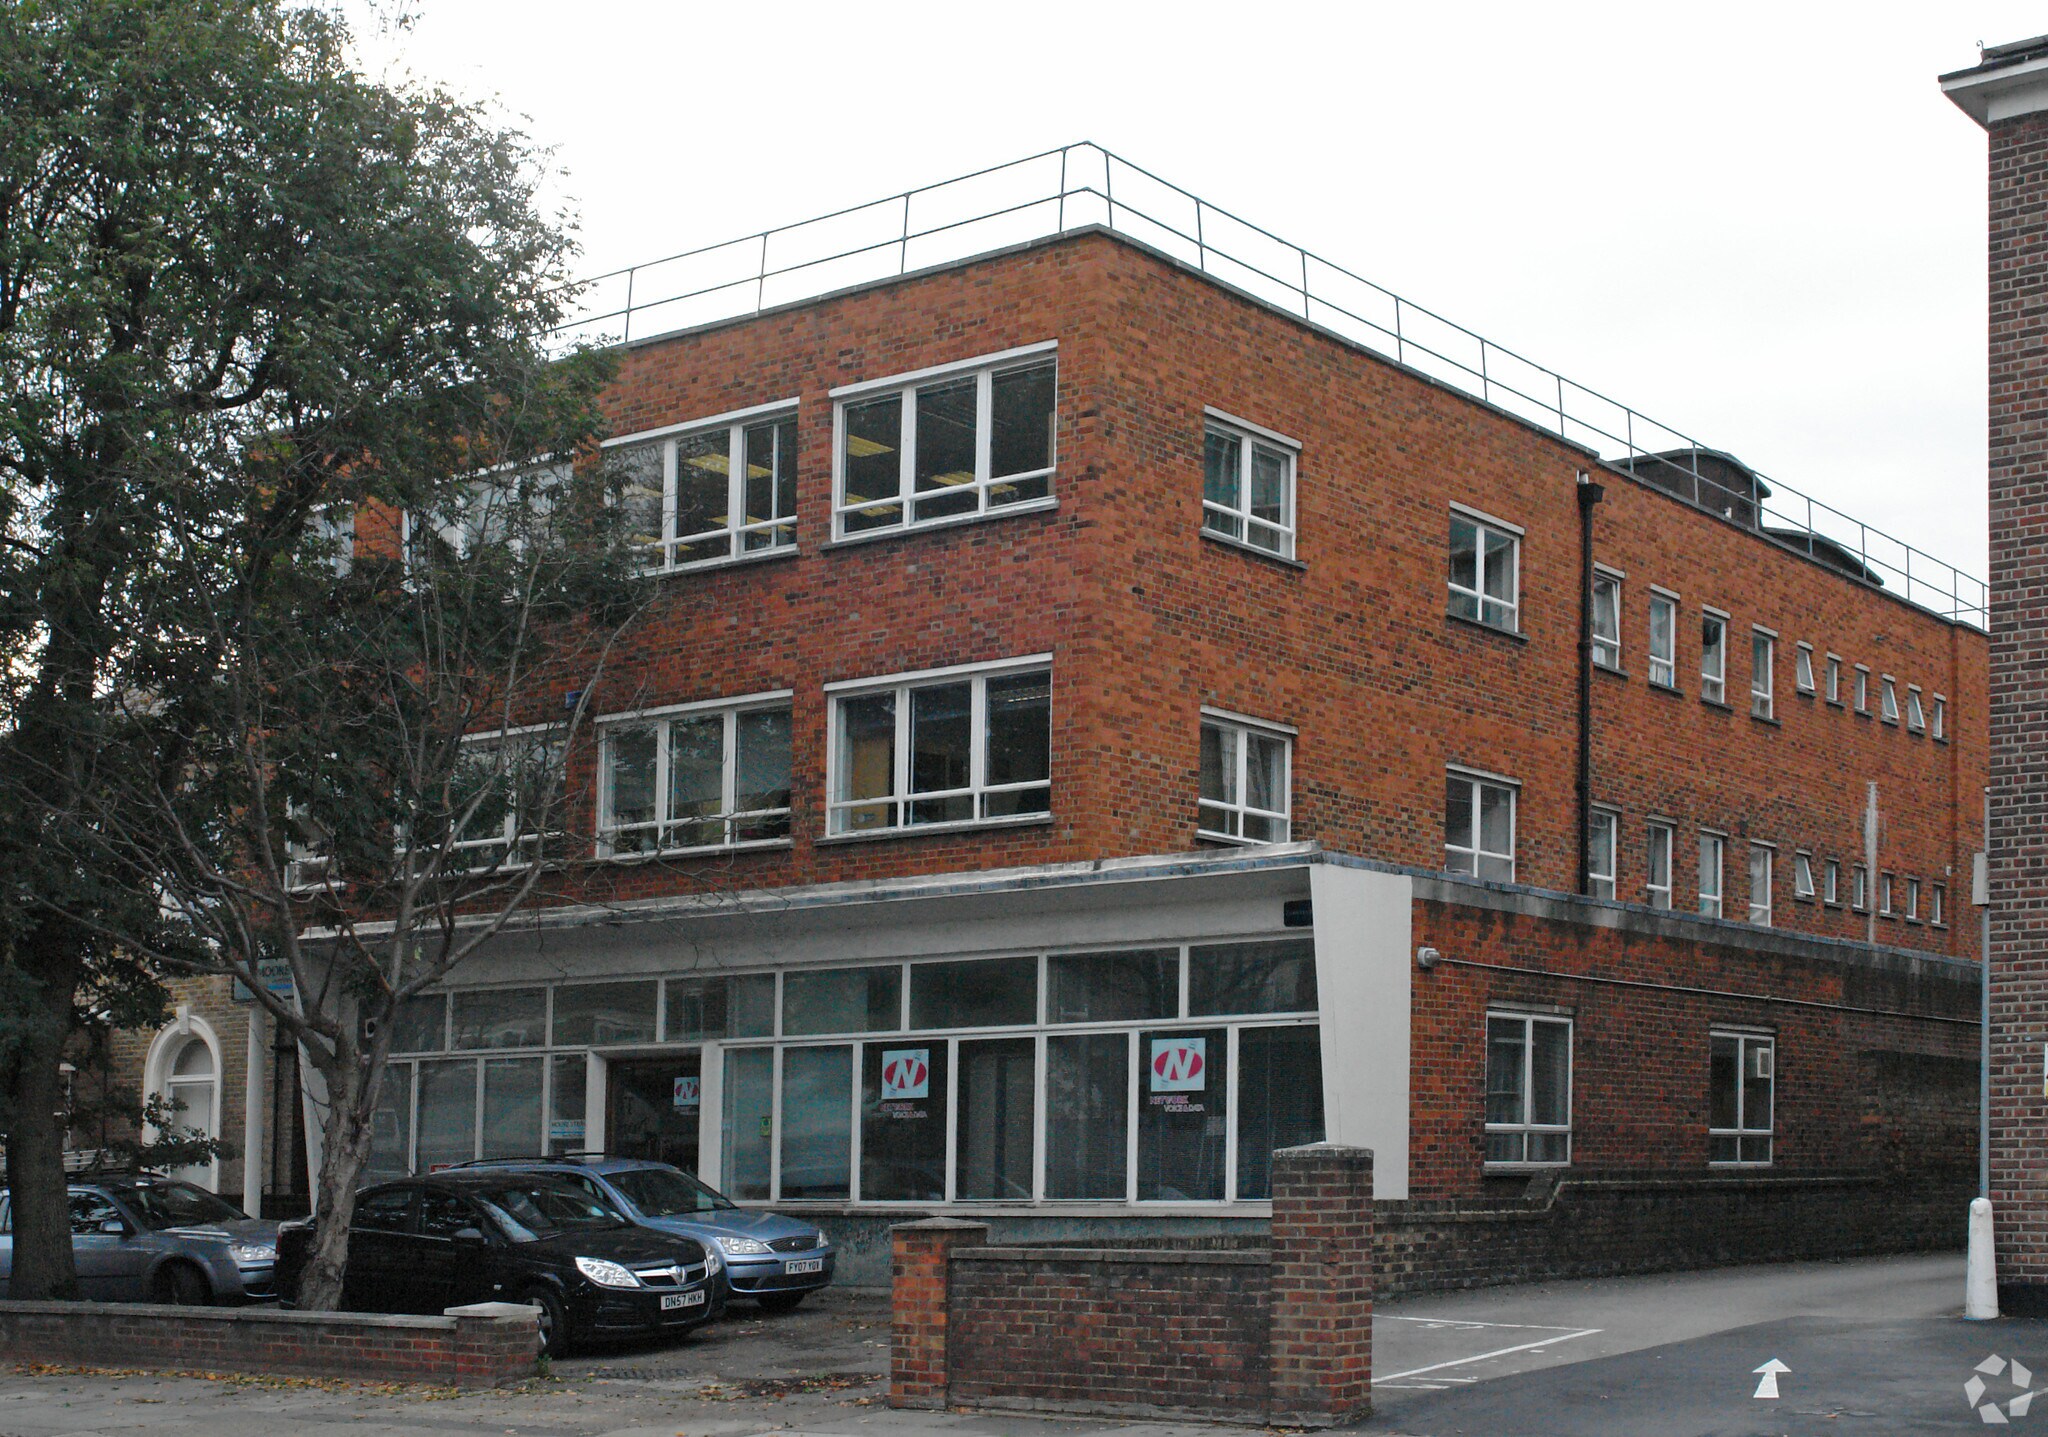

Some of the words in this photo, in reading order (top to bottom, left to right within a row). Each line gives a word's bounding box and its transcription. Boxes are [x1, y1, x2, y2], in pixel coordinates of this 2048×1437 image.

[788, 1261, 807, 1273] FY07
[665, 1294, 687, 1308] DN57
[687, 1291, 703, 1304] HKH
